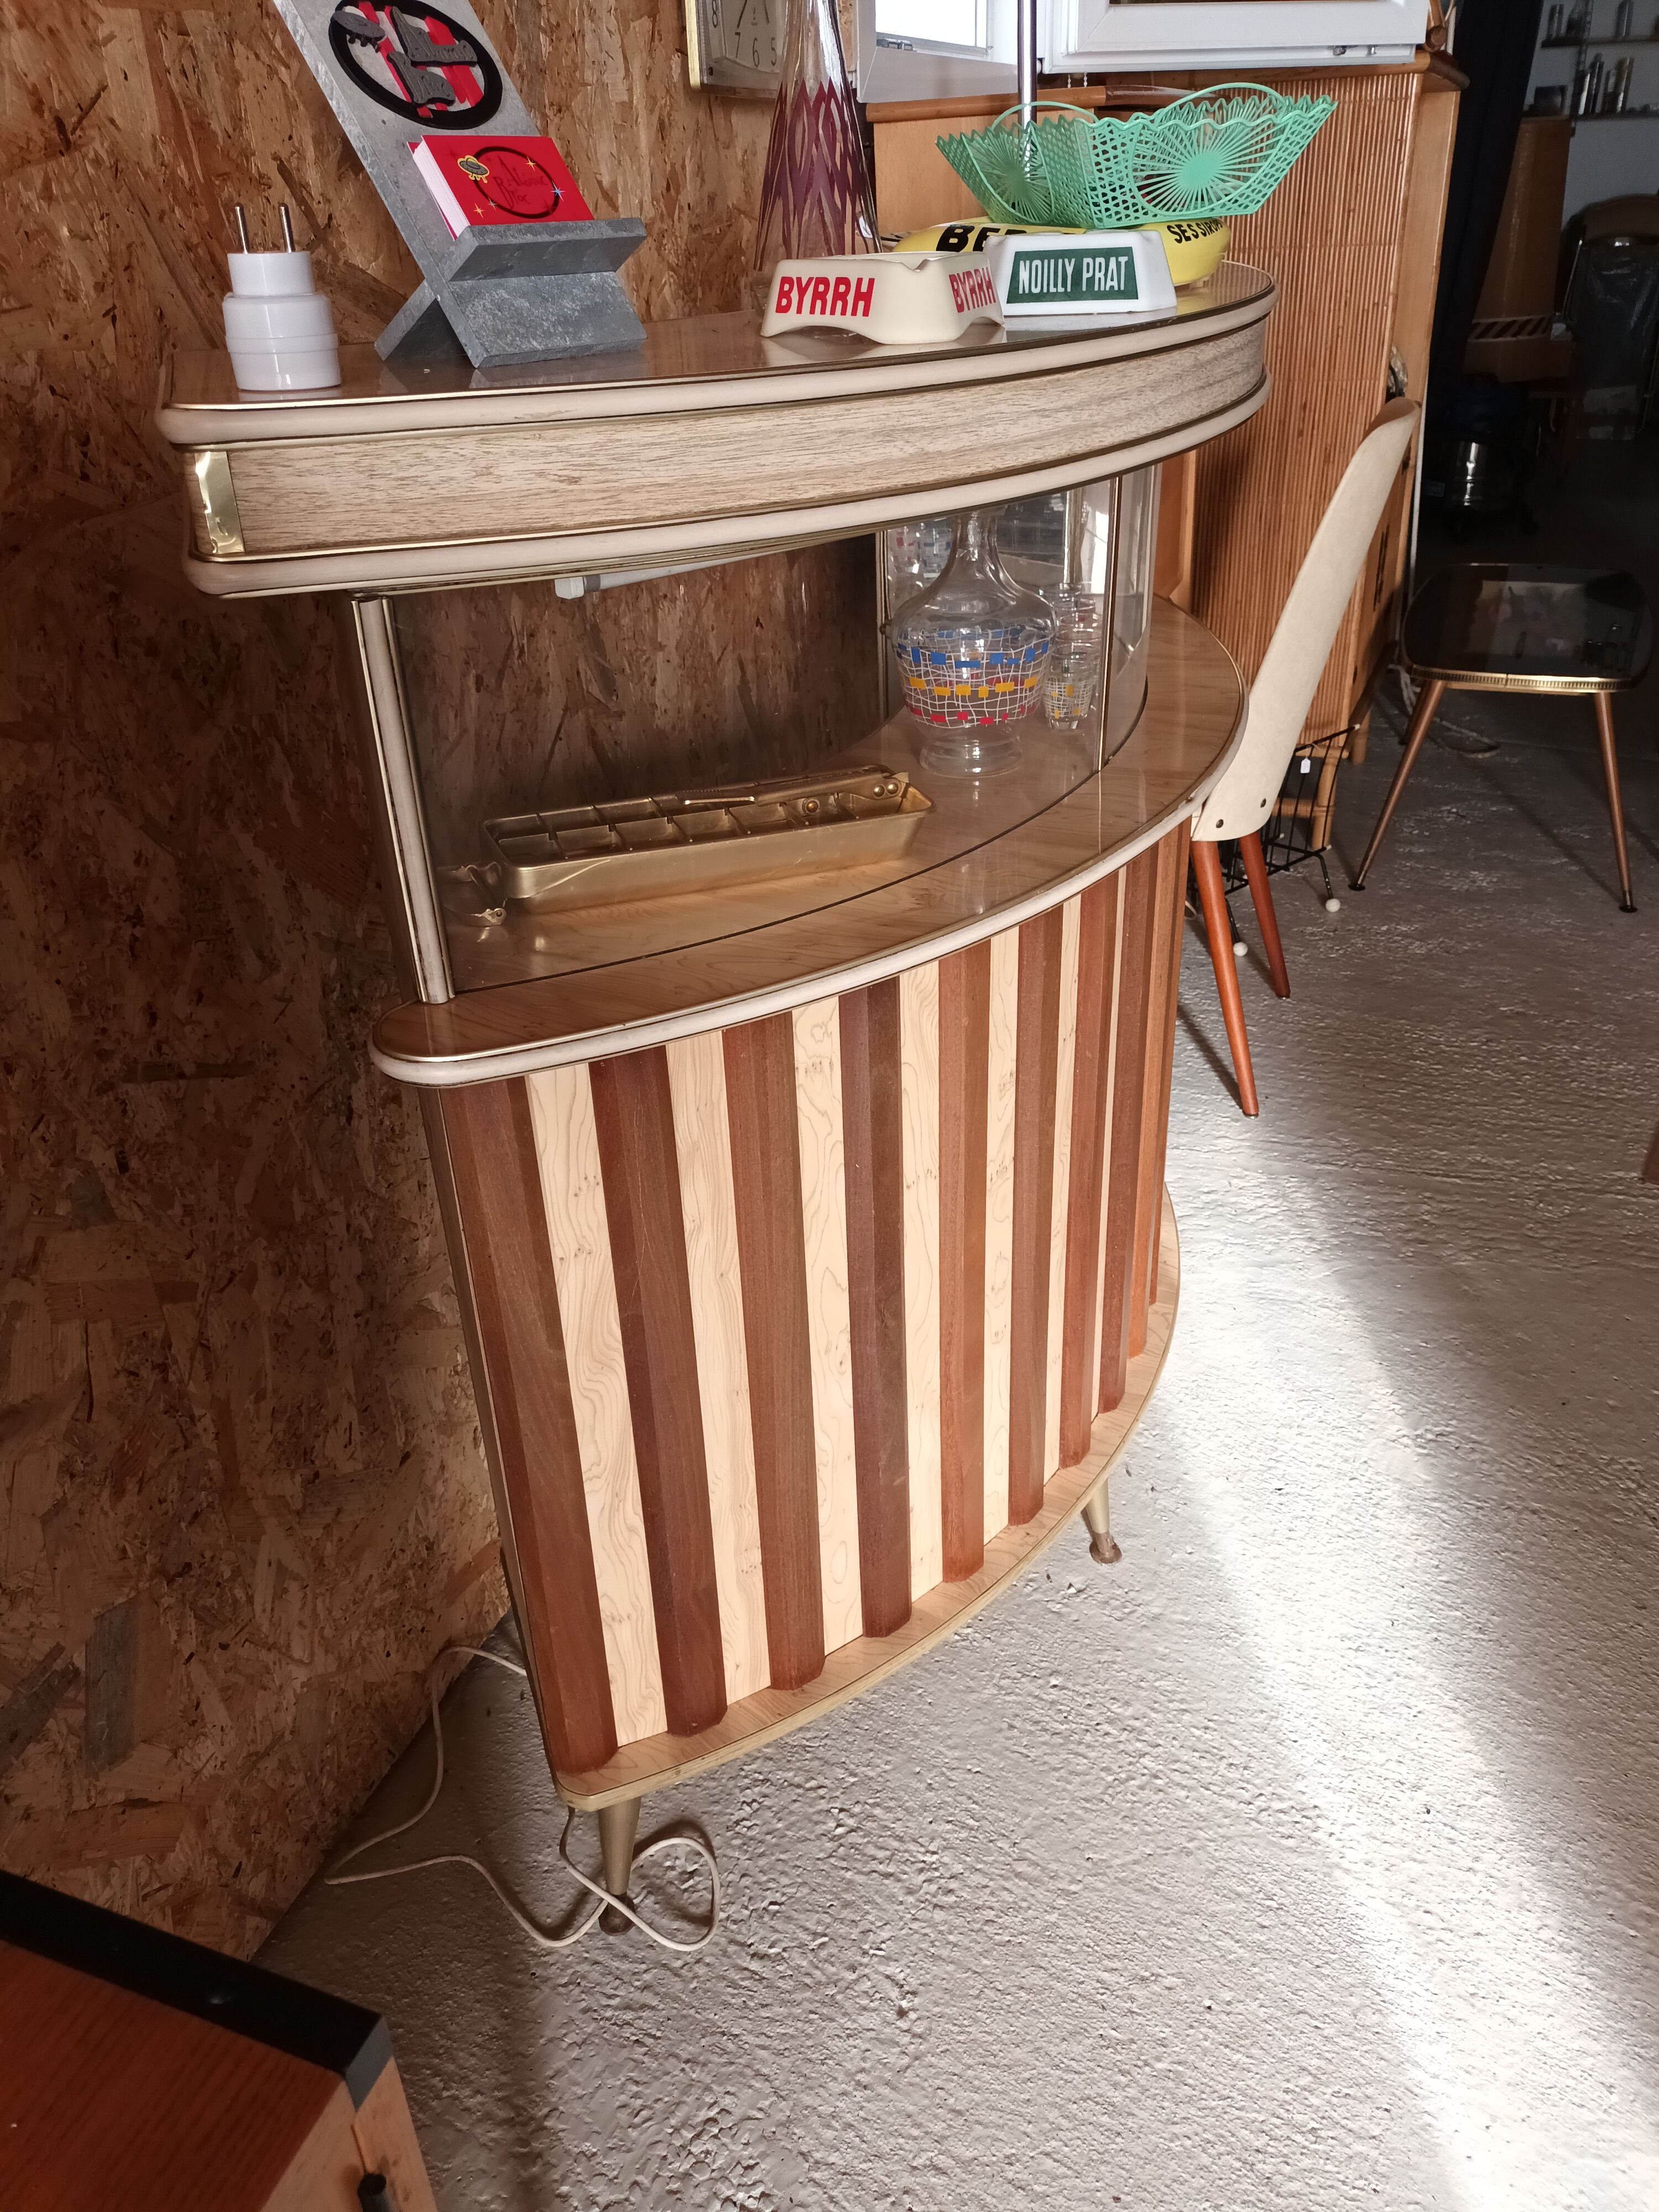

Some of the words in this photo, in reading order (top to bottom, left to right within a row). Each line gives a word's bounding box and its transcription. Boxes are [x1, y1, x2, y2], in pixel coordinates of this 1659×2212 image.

[734, 32, 741, 59] 7
[752, 37, 760, 67] 6
[770, 36, 777, 66] 5
[1166, 223, 1199, 244] SES
[948, 267, 997, 313] BYRRH
[1019, 258, 1076, 294] NOILLY
[1082, 256, 1129, 291] PRAT
[775, 276, 875, 317] BYRRH
